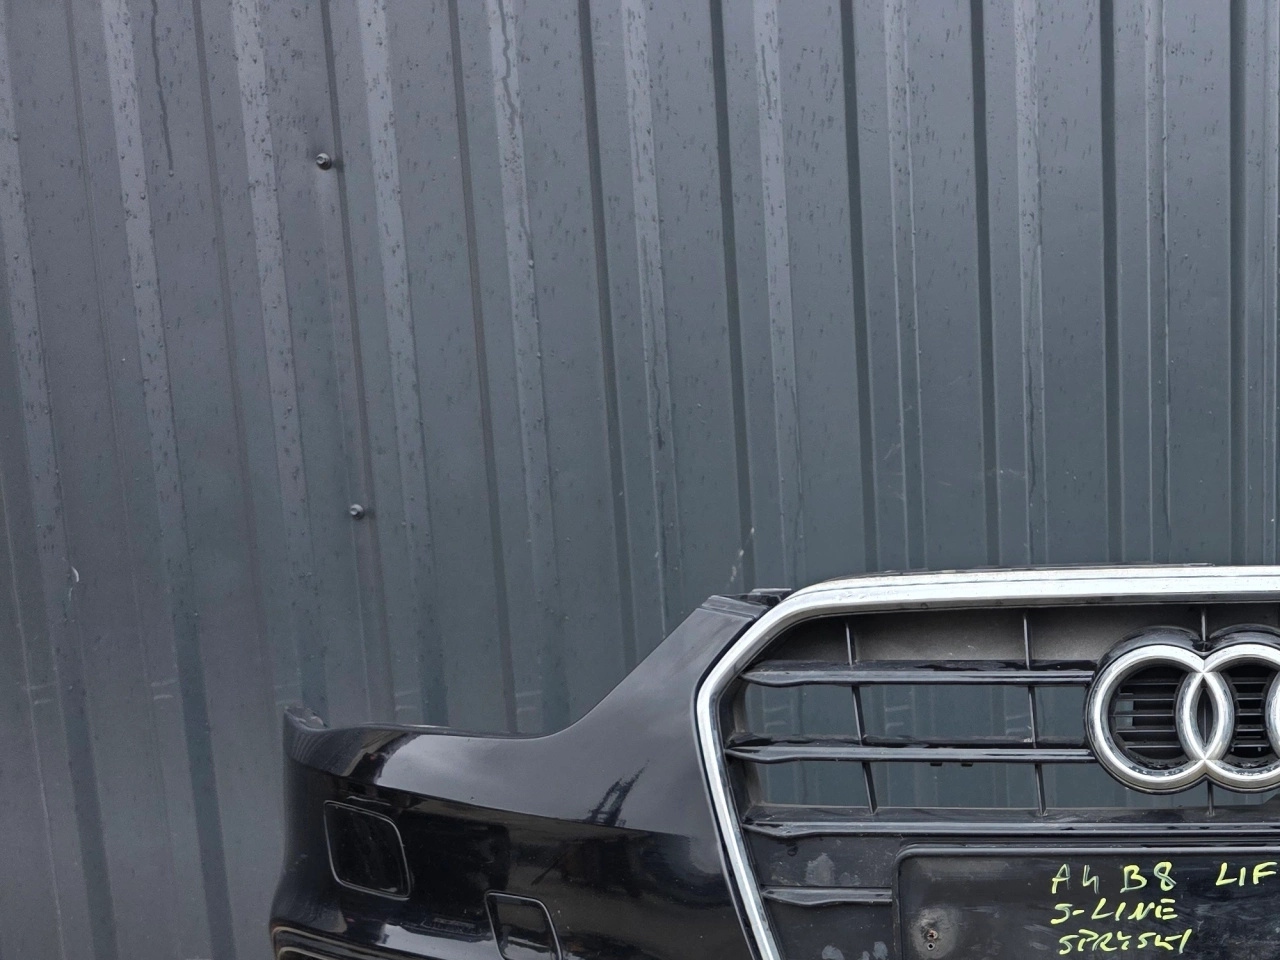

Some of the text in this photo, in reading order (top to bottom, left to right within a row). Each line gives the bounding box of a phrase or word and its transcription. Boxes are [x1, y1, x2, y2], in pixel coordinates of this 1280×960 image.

[1051, 863, 1100, 894] A4
[1119, 861, 1177, 893] B8
[1050, 897, 1178, 925] S-LINE
